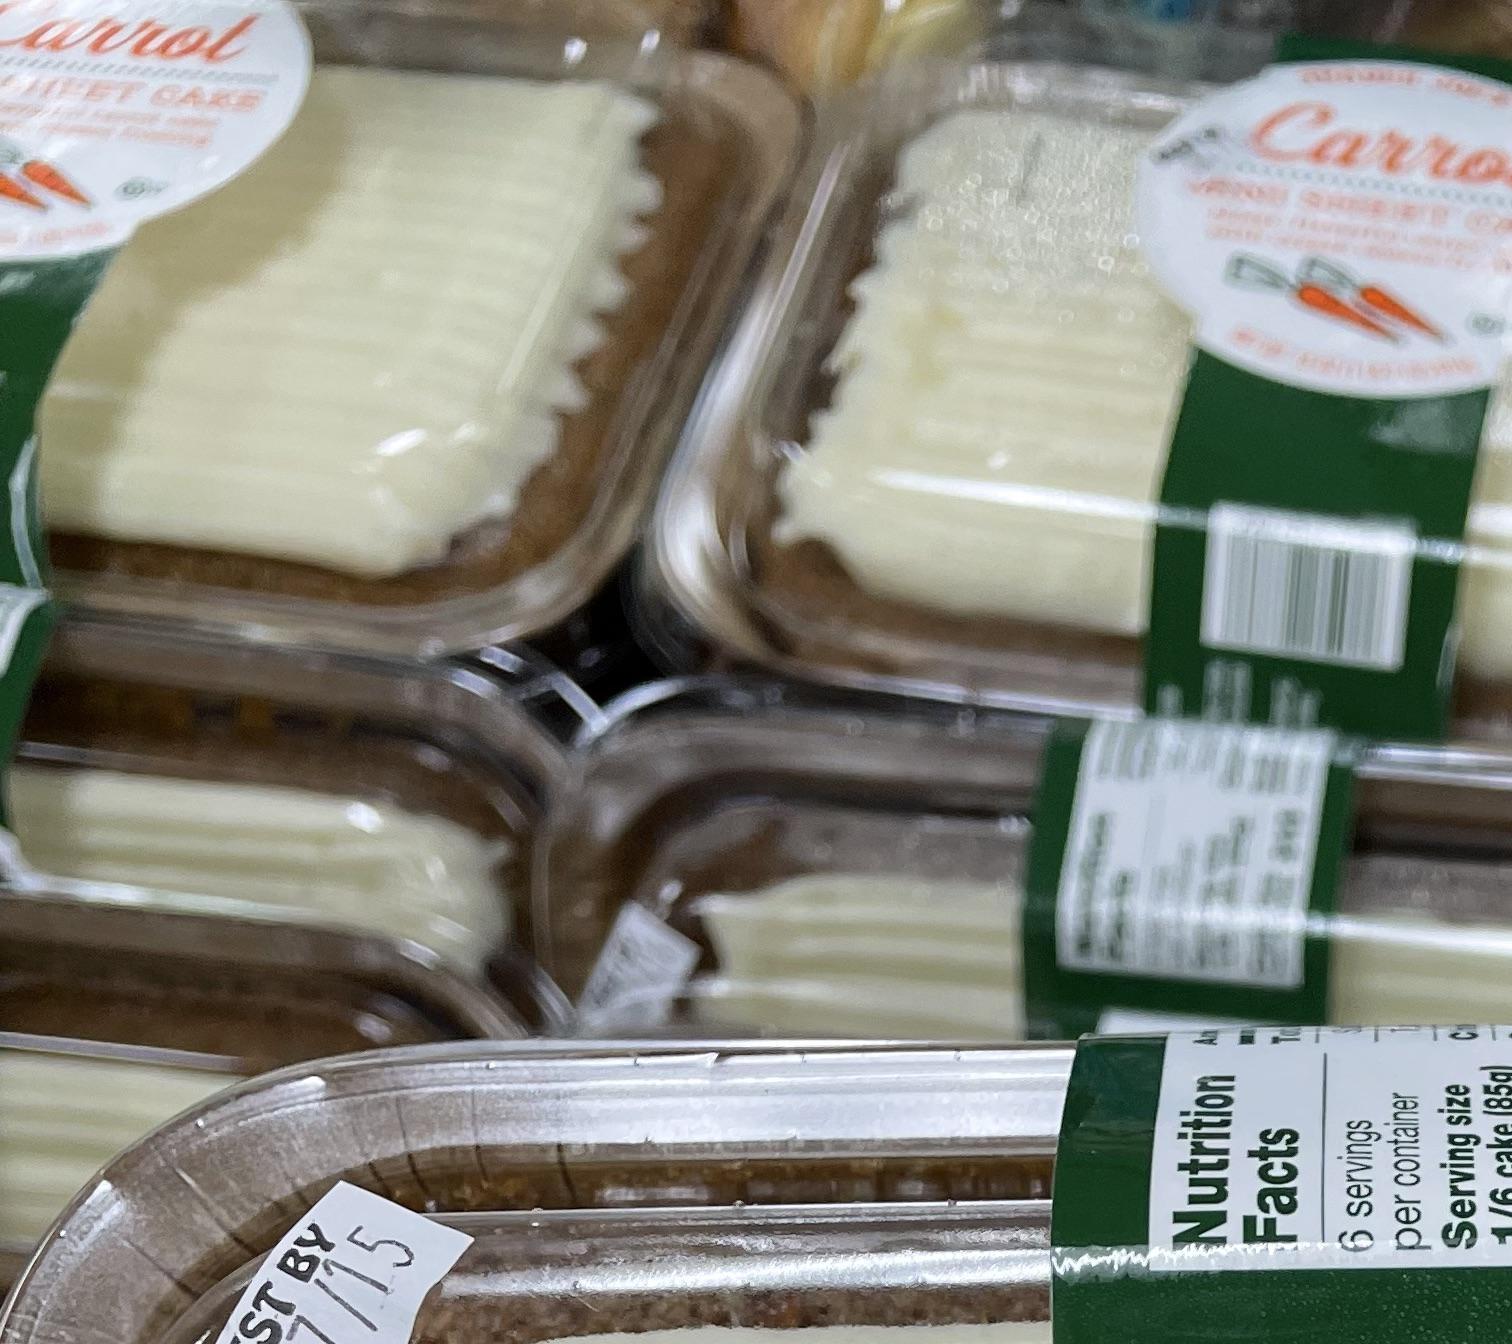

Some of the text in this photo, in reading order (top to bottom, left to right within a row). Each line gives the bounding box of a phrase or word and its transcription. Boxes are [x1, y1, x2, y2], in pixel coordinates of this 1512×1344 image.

[0, 12, 262, 63] arrot
[1172, 1075, 1236, 1249] Nutrition
[1243, 1129, 1299, 1244] Facts
[1338, 1121, 1381, 1251] 6 servings
[1383, 1092, 1432, 1250] per container
[1438, 1085, 1480, 1249] Serving size
[276, 1222, 336, 1284] BY
